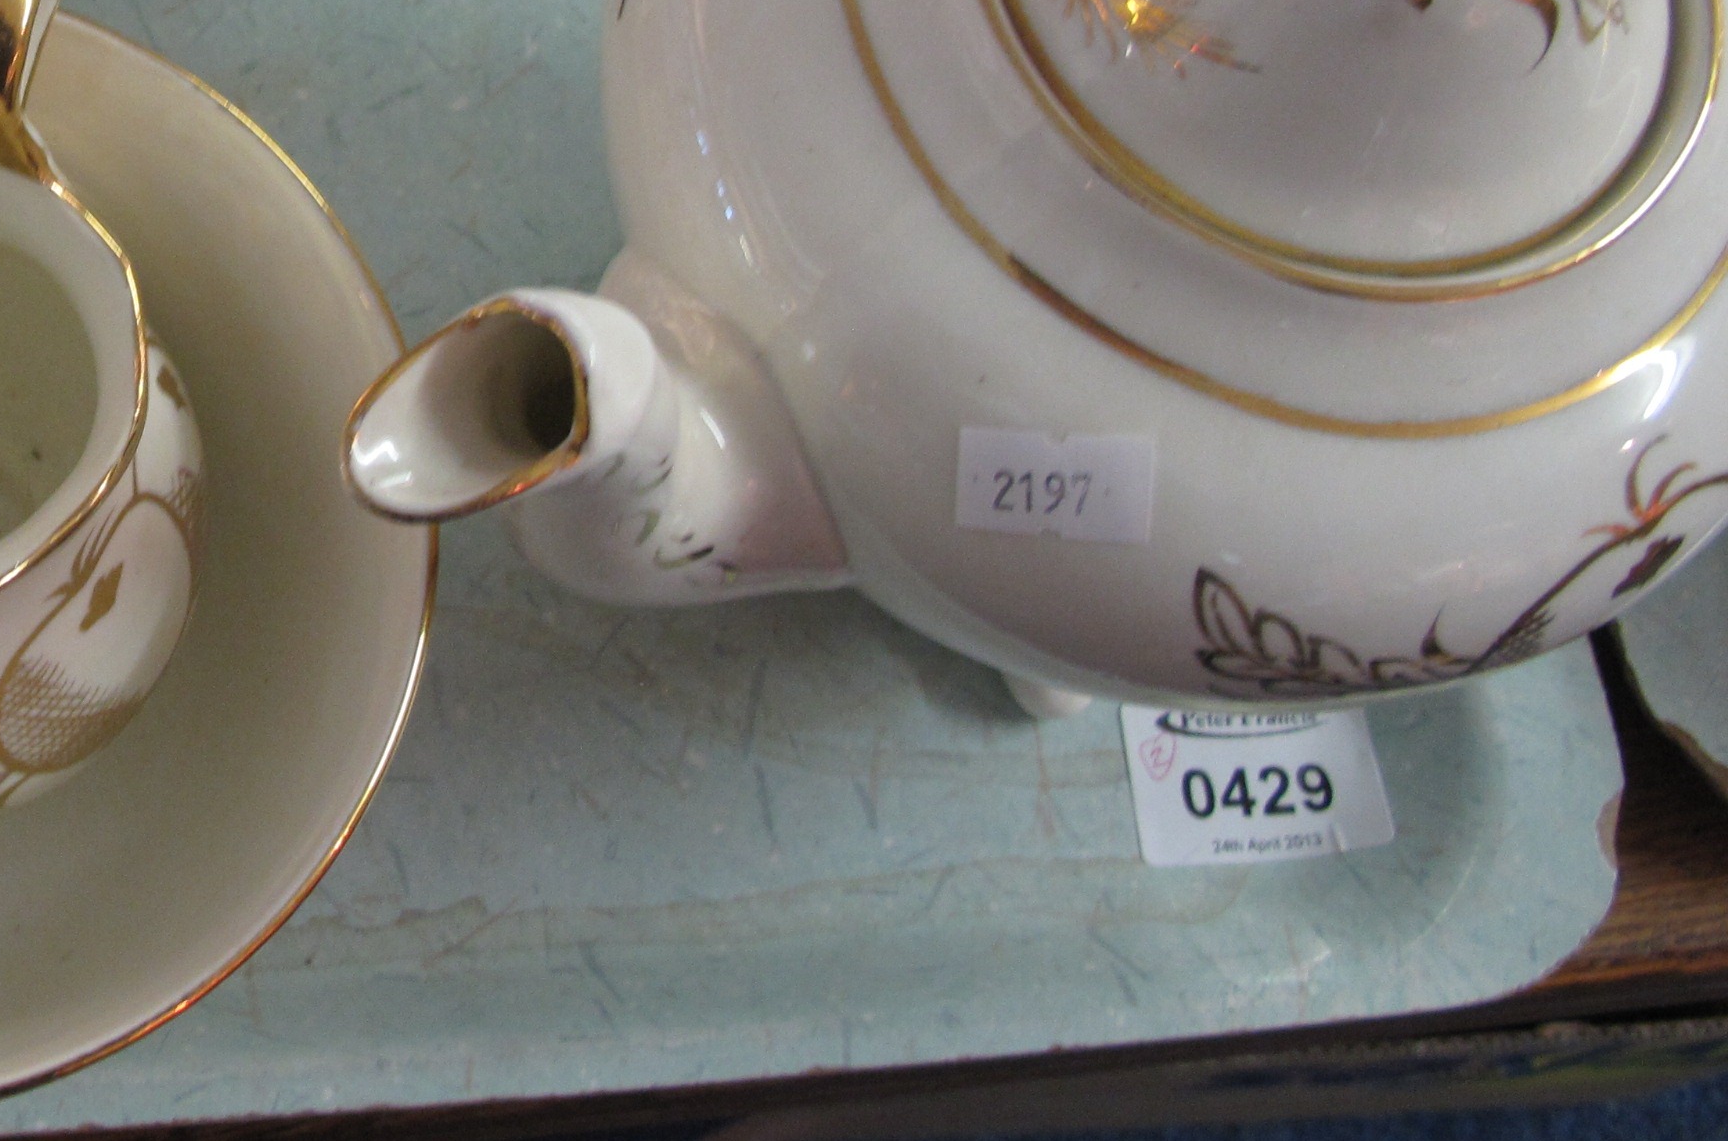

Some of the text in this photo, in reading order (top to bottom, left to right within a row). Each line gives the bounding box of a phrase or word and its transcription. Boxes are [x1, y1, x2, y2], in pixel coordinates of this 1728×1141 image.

[990, 469, 1092, 517] 2197
[1182, 763, 1334, 819] 0429
[1212, 832, 1323, 856] 24th April 2013
